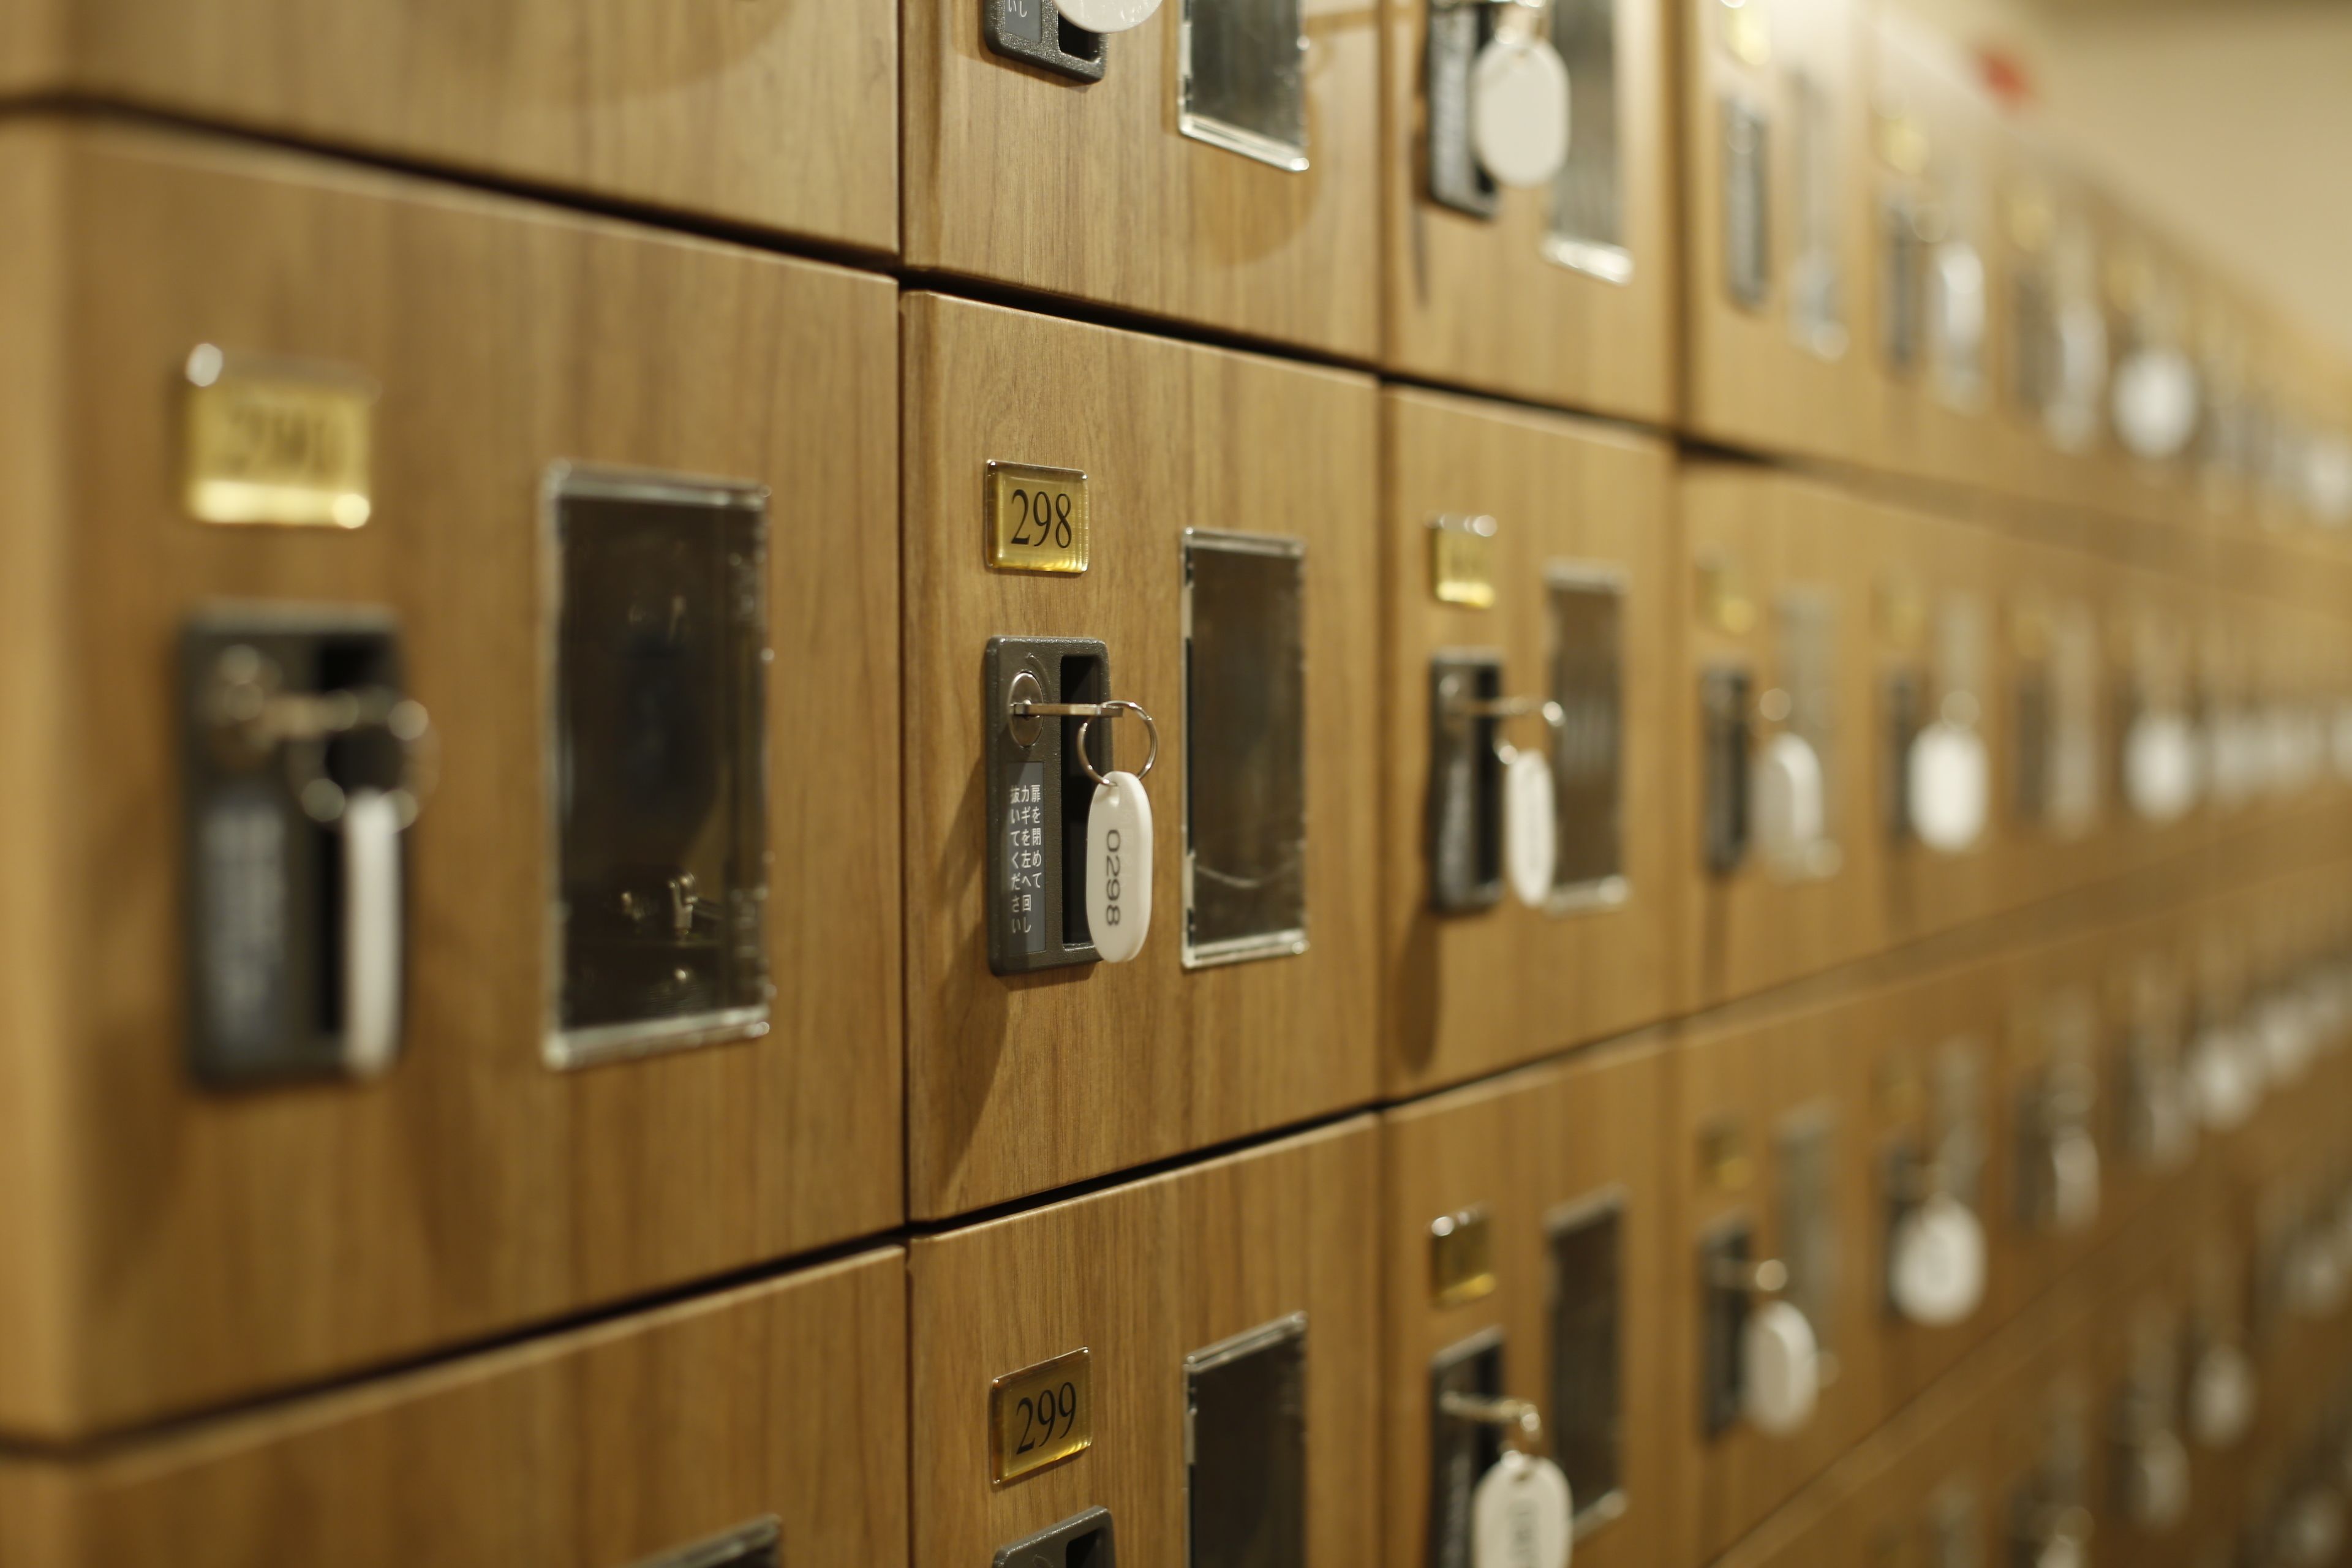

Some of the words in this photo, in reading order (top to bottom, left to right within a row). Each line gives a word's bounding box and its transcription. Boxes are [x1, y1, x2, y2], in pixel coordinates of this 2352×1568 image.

[1011, 489, 1072, 549] 298
[1031, 784, 1042, 888] 扉を閉めて
[1106, 829, 1121, 925] 0298
[1016, 1381, 1077, 1455] 299
